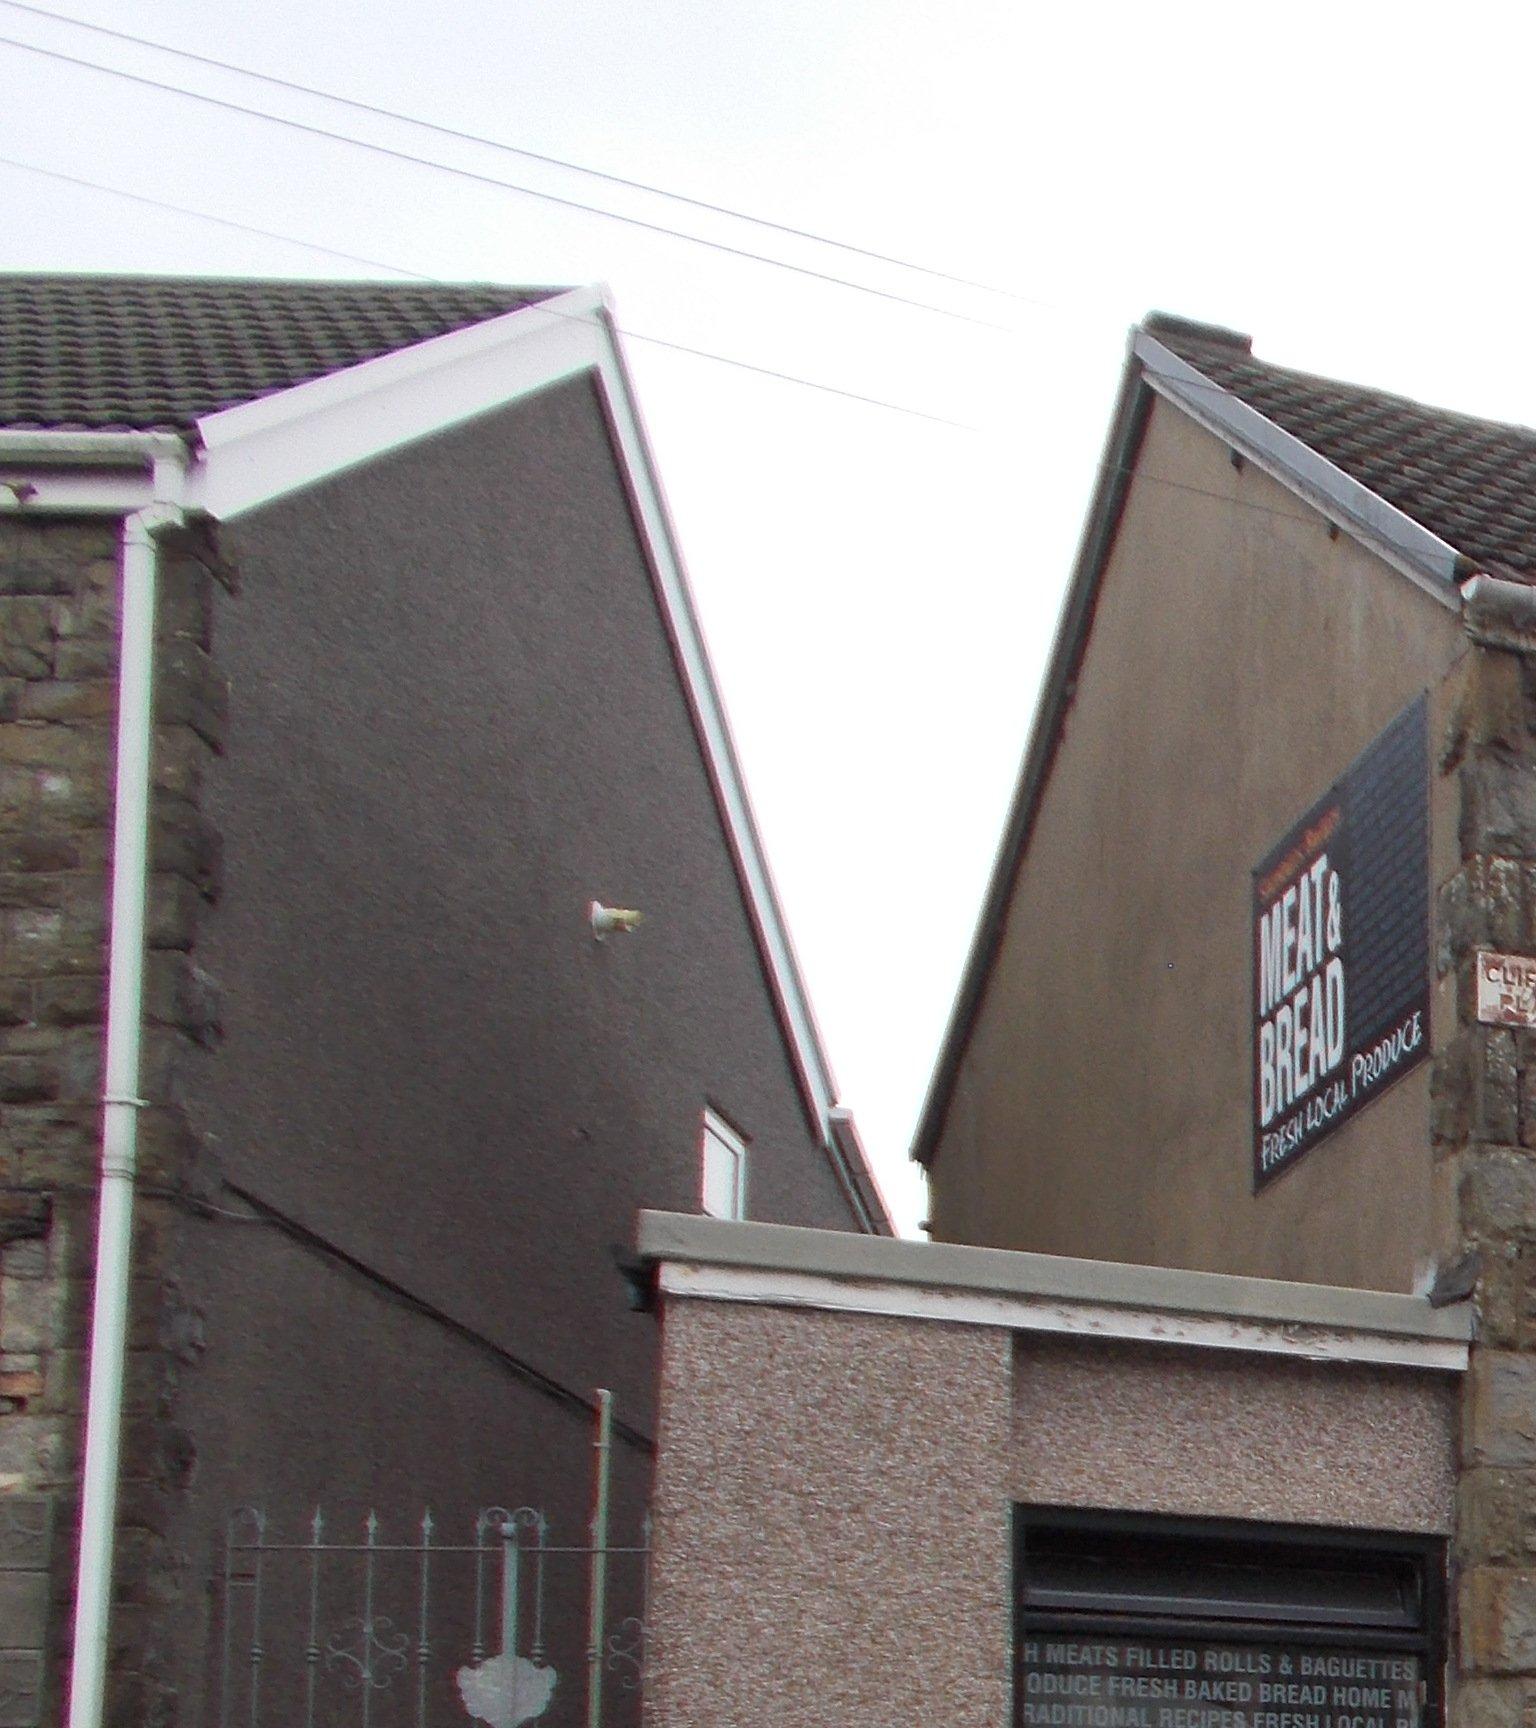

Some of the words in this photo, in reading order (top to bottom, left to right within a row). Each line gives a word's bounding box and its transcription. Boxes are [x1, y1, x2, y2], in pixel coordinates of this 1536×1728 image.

[1259, 853, 1329, 1018] MEAT
[1327, 870, 1343, 952] &
[1259, 956, 1346, 1128] BREAD
[1262, 1117, 1303, 1172] FRESH
[1306, 1077, 1349, 1131] LOCAL
[1350, 1009, 1423, 1099] PRODUCE
[1046, 1644, 1118, 1667] MEATS
[1126, 1647, 1197, 1670] FILLED
[1205, 1651, 1272, 1674] ROLLS
[1279, 1654, 1293, 1675] &
[1301, 1656, 1417, 1681] BAGUETTES
[1108, 1676, 1178, 1699] FRESH
[1184, 1679, 1252, 1702] BAKED
[1259, 1682, 1327, 1705] BREAD
[1333, 1686, 1392, 1709] HOME
